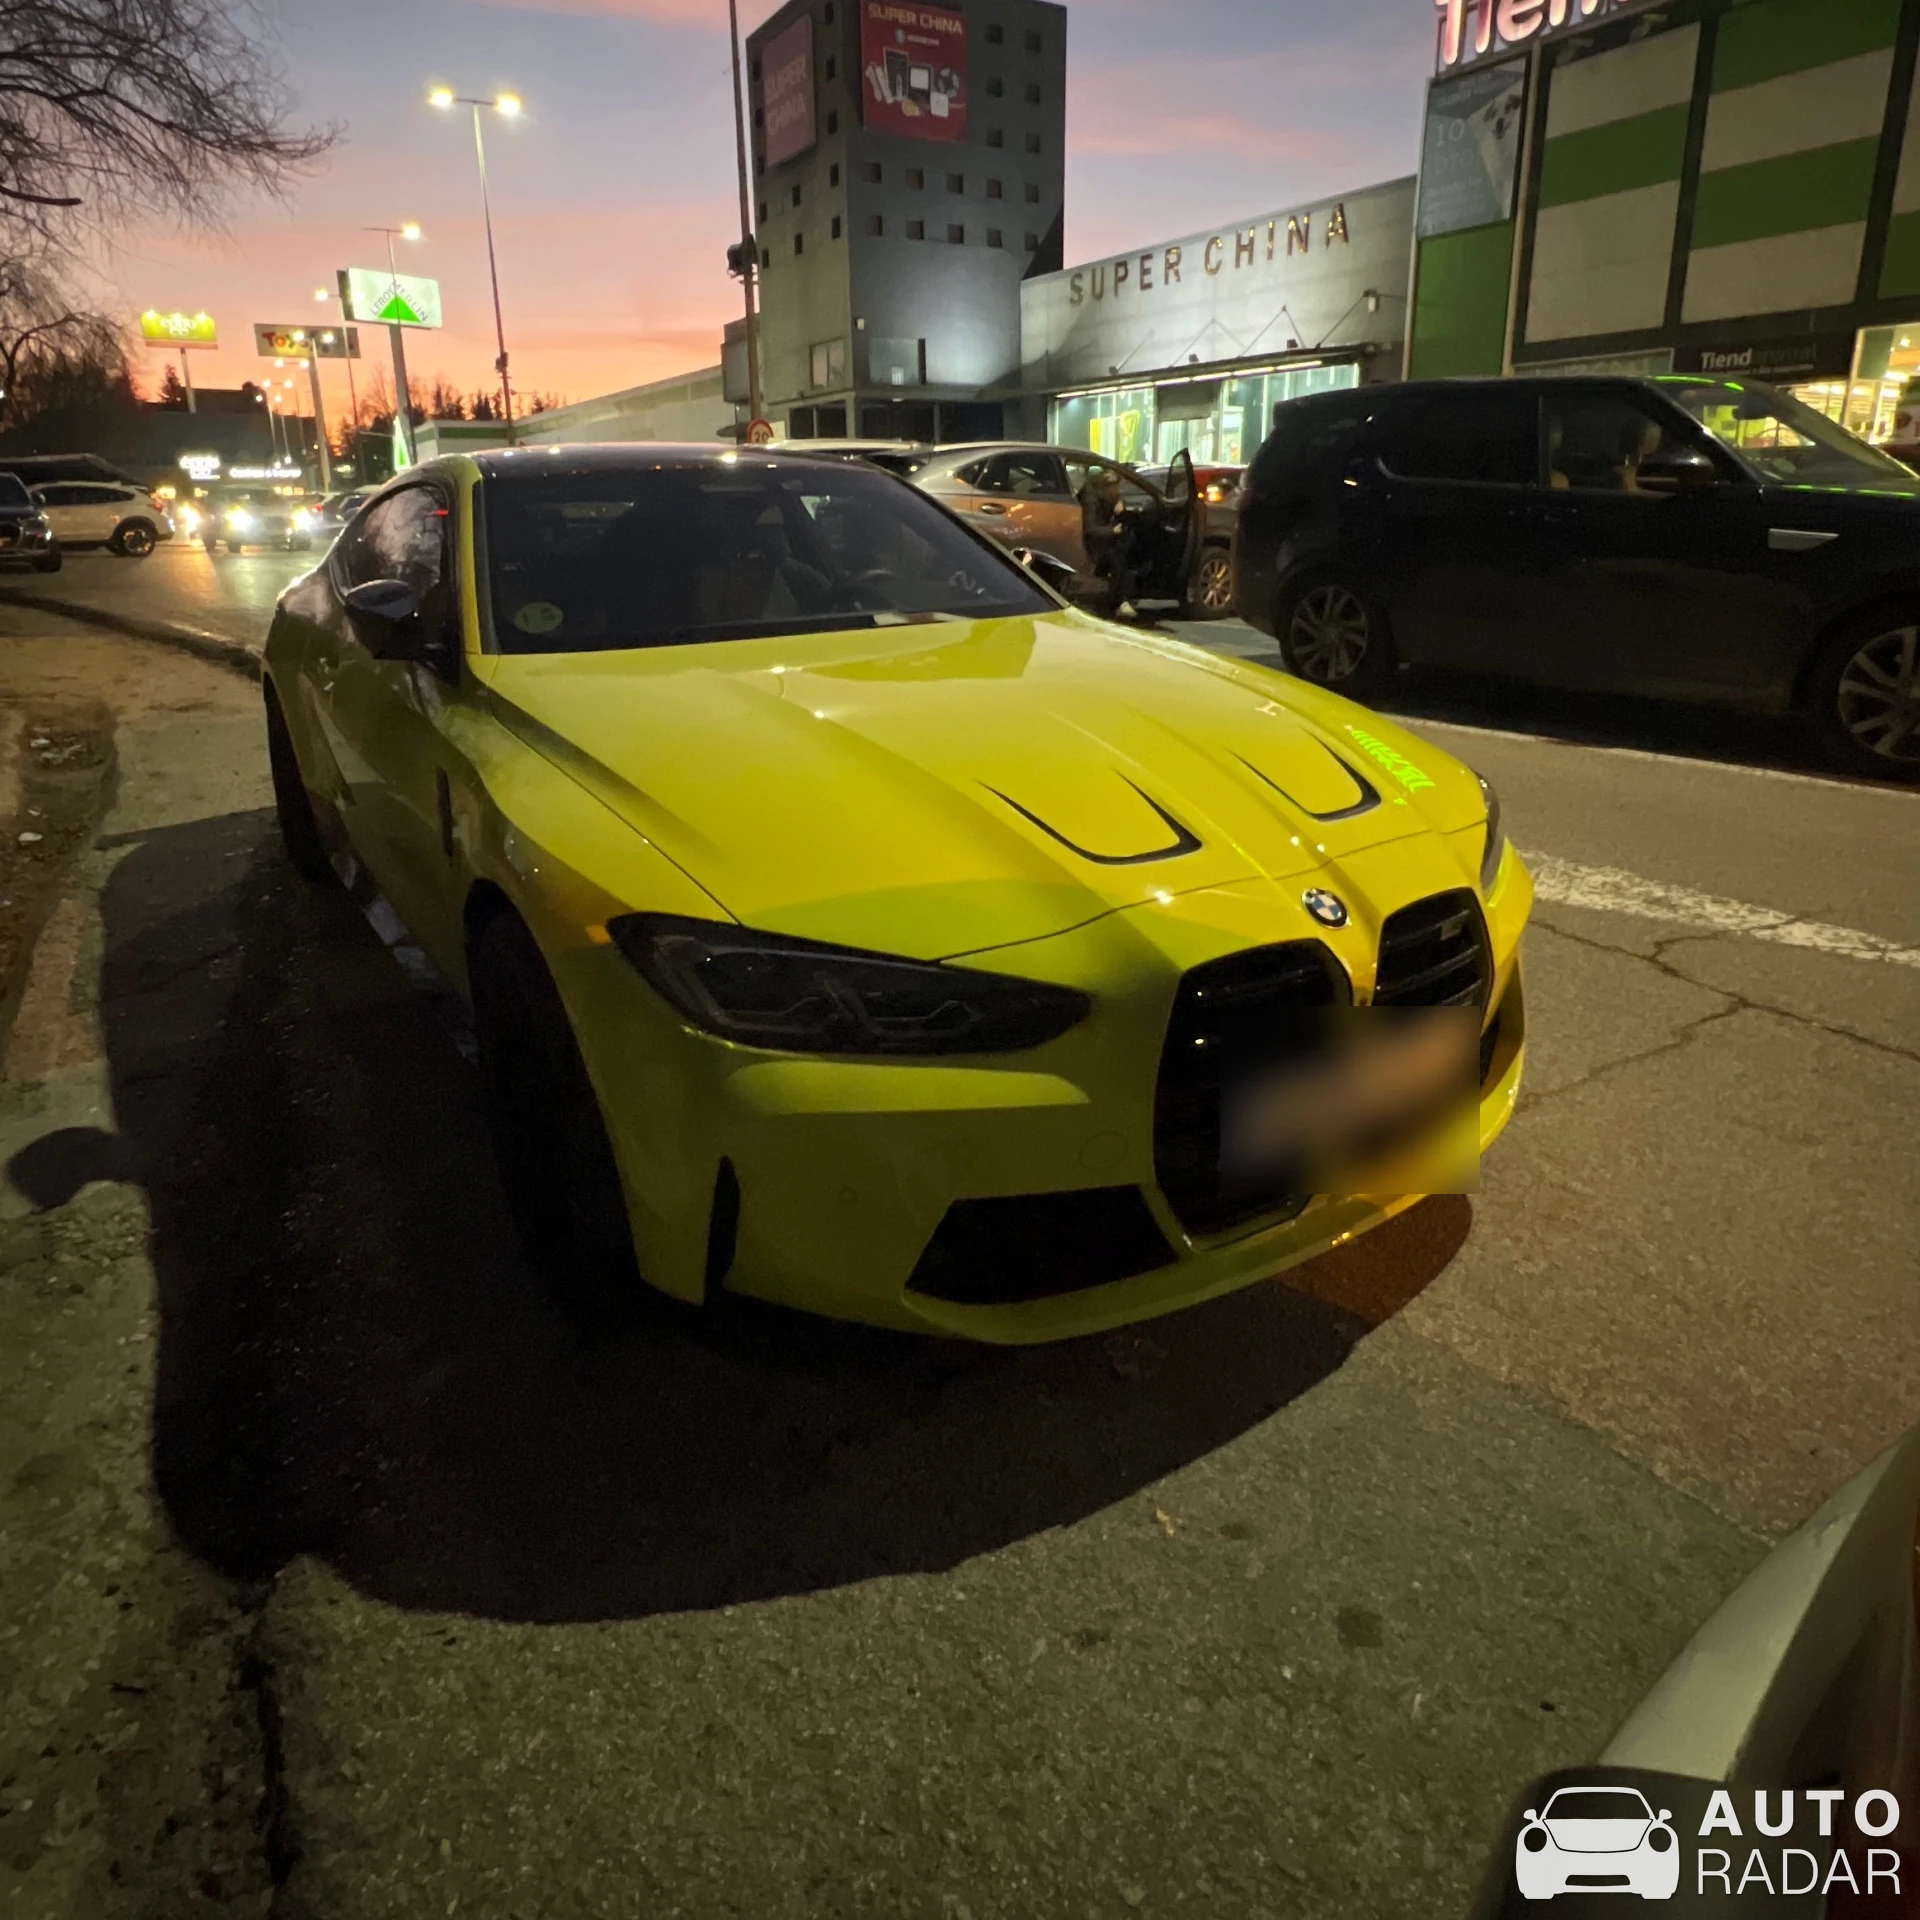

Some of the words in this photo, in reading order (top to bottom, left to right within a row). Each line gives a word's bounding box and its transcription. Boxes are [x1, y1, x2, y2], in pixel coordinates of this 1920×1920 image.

[868, 3, 917, 25] SUPER
[919, 13, 963, 35] CHINA
[767, 92, 806, 136] CHINA
[1069, 246, 1182, 306] SUPER
[1203, 202, 1349, 276] CHINA
[370, 284, 396, 316] LEROY
[392, 278, 429, 322] MERLIN
